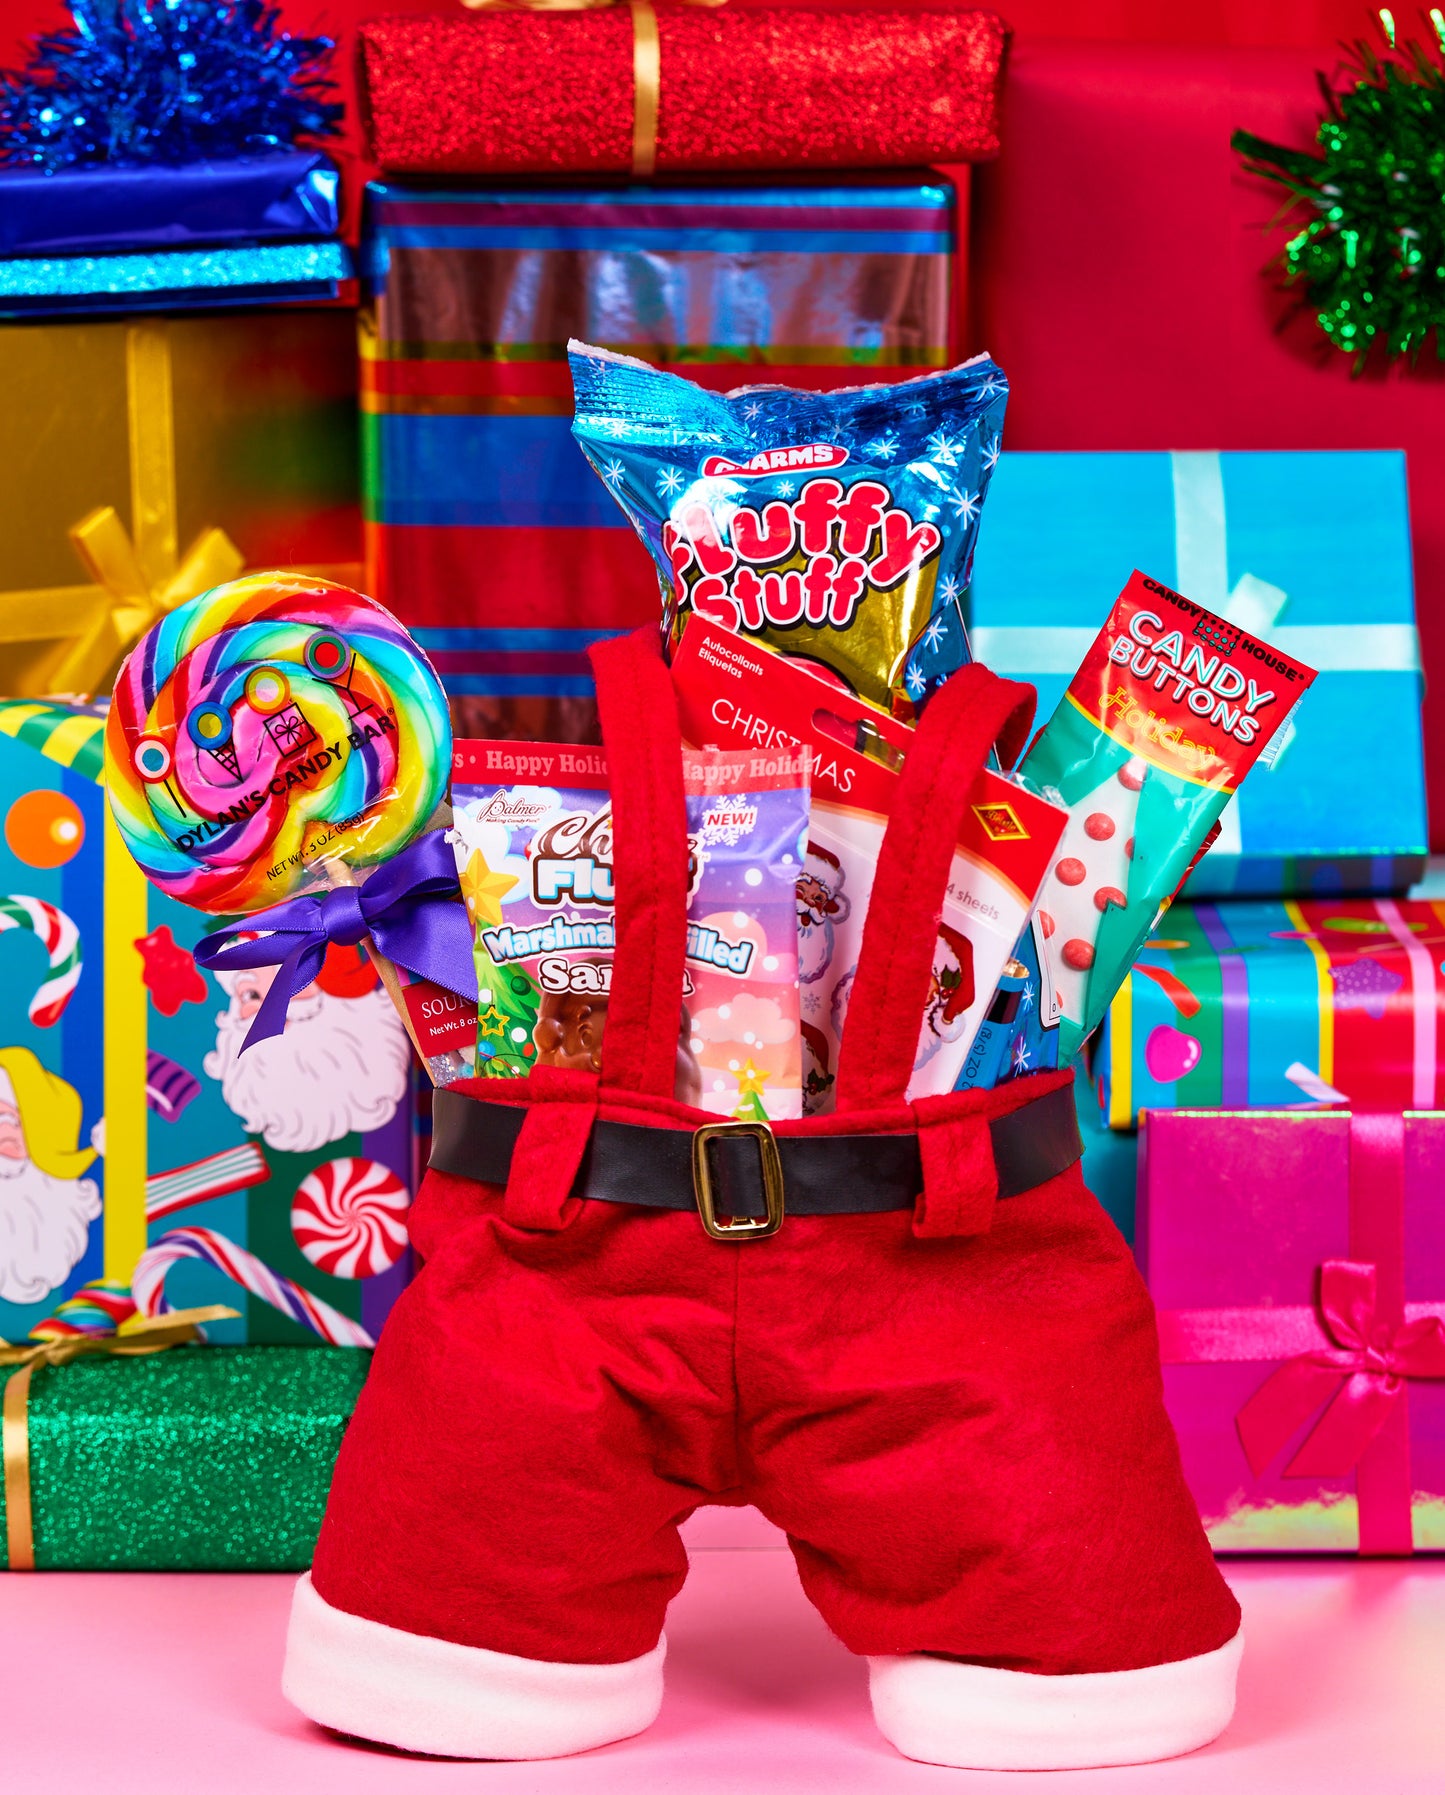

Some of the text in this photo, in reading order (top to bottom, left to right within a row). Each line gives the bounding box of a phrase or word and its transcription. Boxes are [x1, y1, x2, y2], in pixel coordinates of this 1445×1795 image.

[1142, 578, 1201, 618] CANDY
[698, 648, 743, 679] Etiquetas
[702, 636, 764, 676] Autocollants
[1128, 610, 1276, 714] CANDY
[1108, 635, 1262, 745] BUTTONS
[1098, 686, 1217, 771] Holiday
[486, 750, 554, 776] Happy
[176, 790, 267, 853] DYLAN'S
[268, 741, 343, 796] CANDY
[707, 812, 754, 826] NEW!
[266, 860, 288, 881] NET
[957, 890, 1000, 920] sheets
[482, 916, 616, 963] Marshma
[459, 1018, 466, 1028] 8
[965, 1057, 980, 1079] OZ
